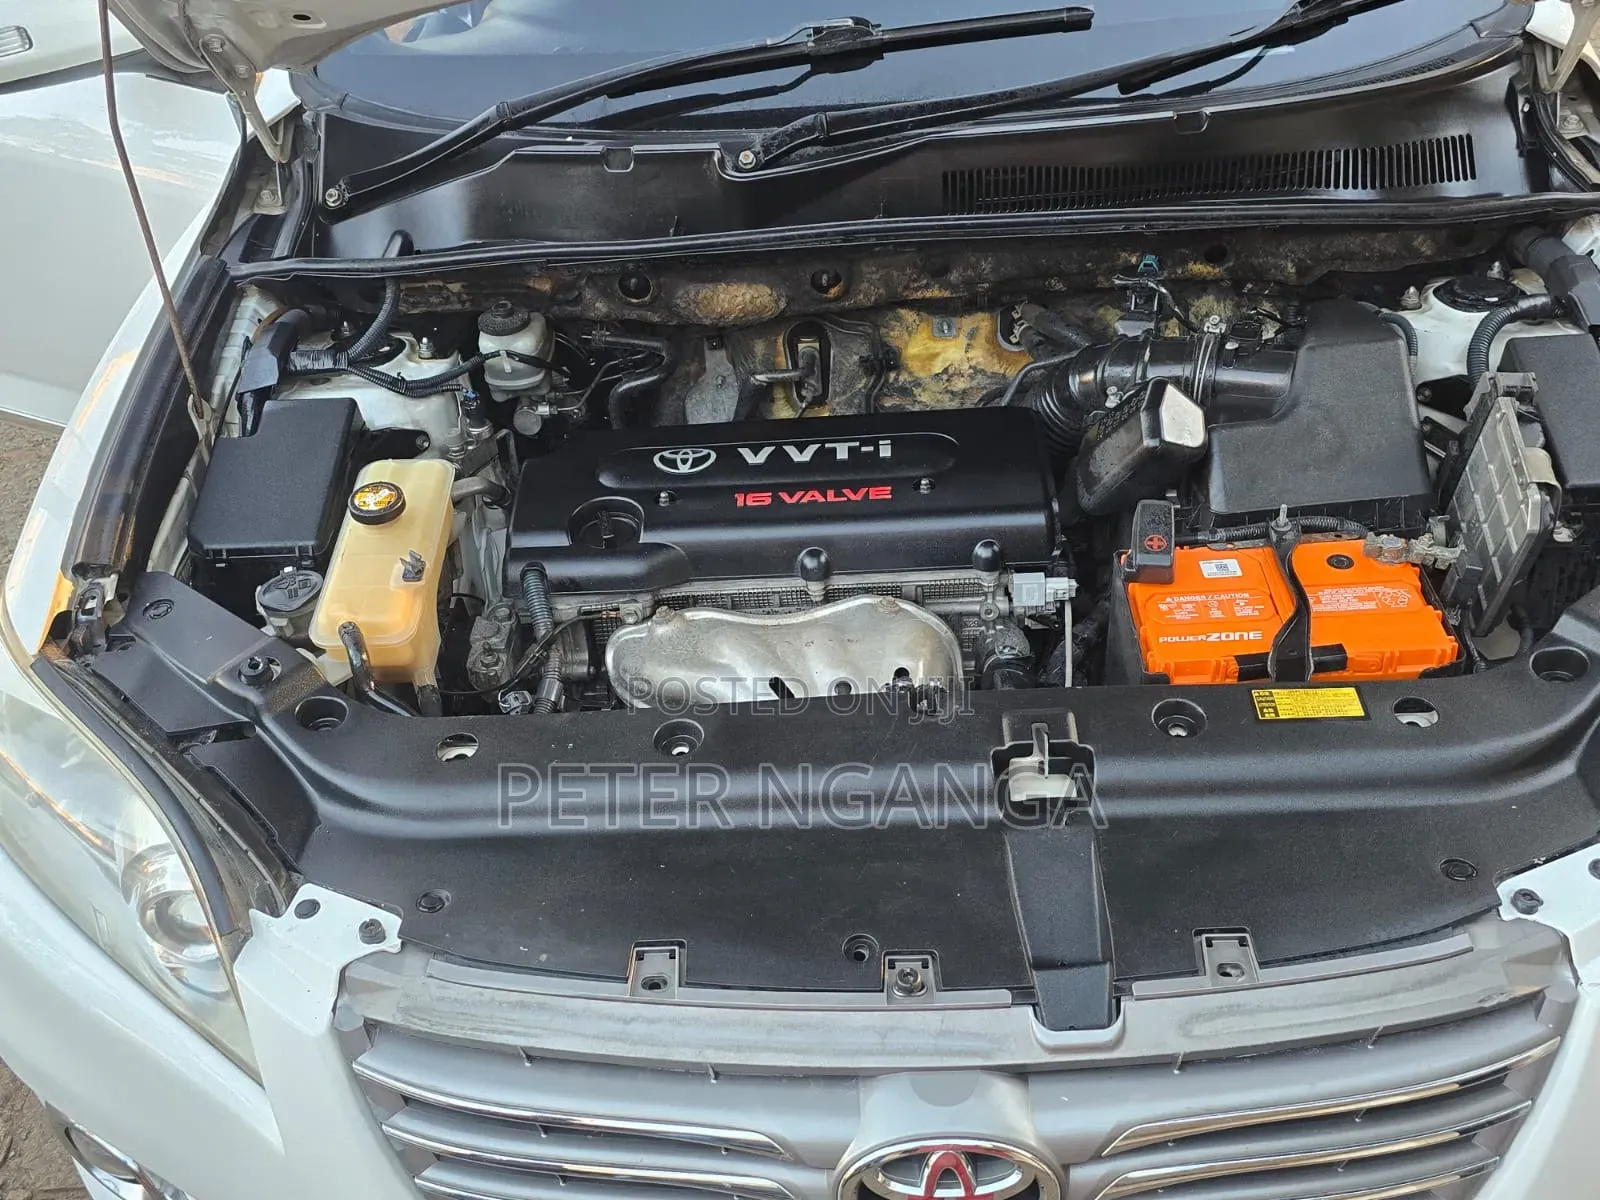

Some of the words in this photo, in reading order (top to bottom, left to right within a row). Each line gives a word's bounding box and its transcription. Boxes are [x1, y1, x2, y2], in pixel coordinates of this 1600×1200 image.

[737, 440, 892, 464] VVT-i
[734, 491, 772, 507] 16
[779, 486, 893, 504] VALVE
